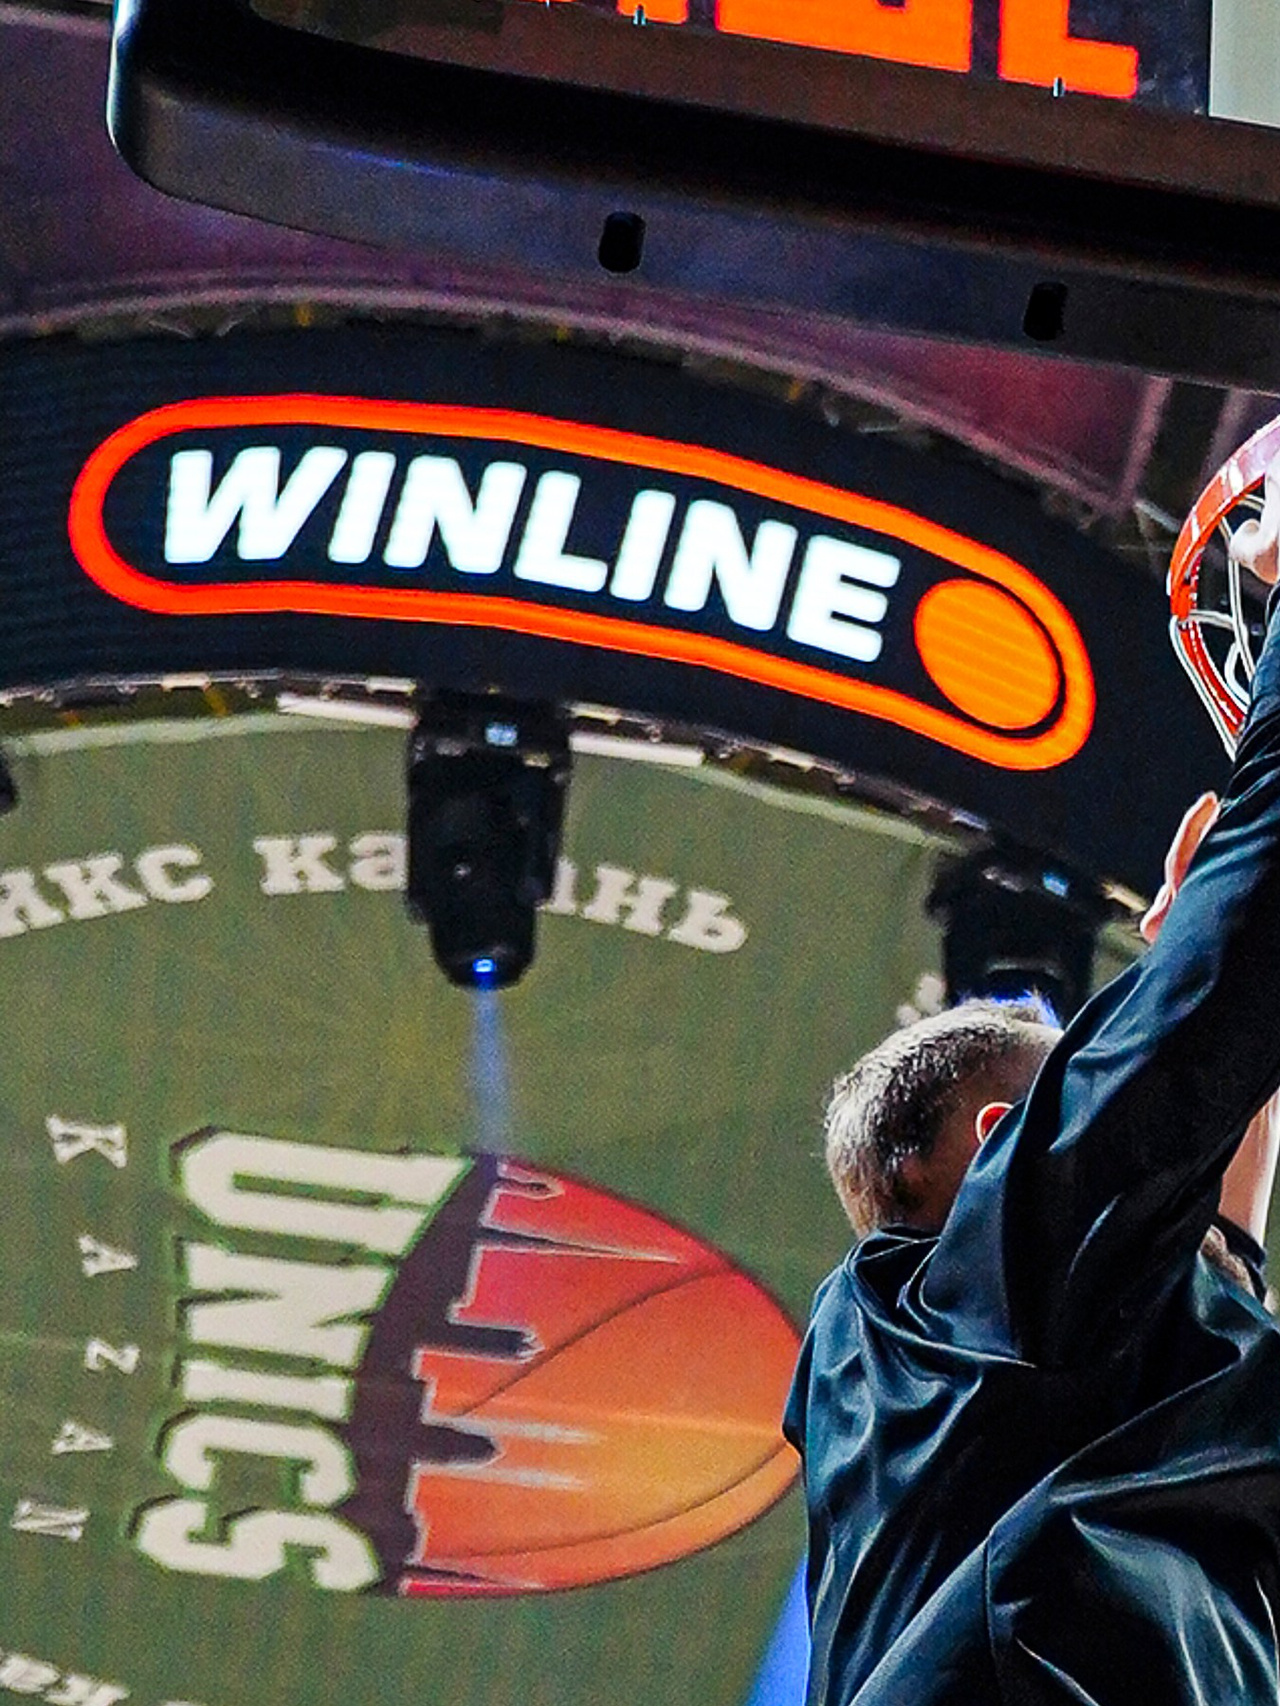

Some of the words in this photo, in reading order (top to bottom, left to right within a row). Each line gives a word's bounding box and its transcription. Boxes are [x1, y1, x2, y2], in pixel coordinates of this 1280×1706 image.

[164, 445, 901, 663] WINLINE
[11, 1113, 141, 1542] KAZAN
[136, 1130, 475, 1592] UNICS
